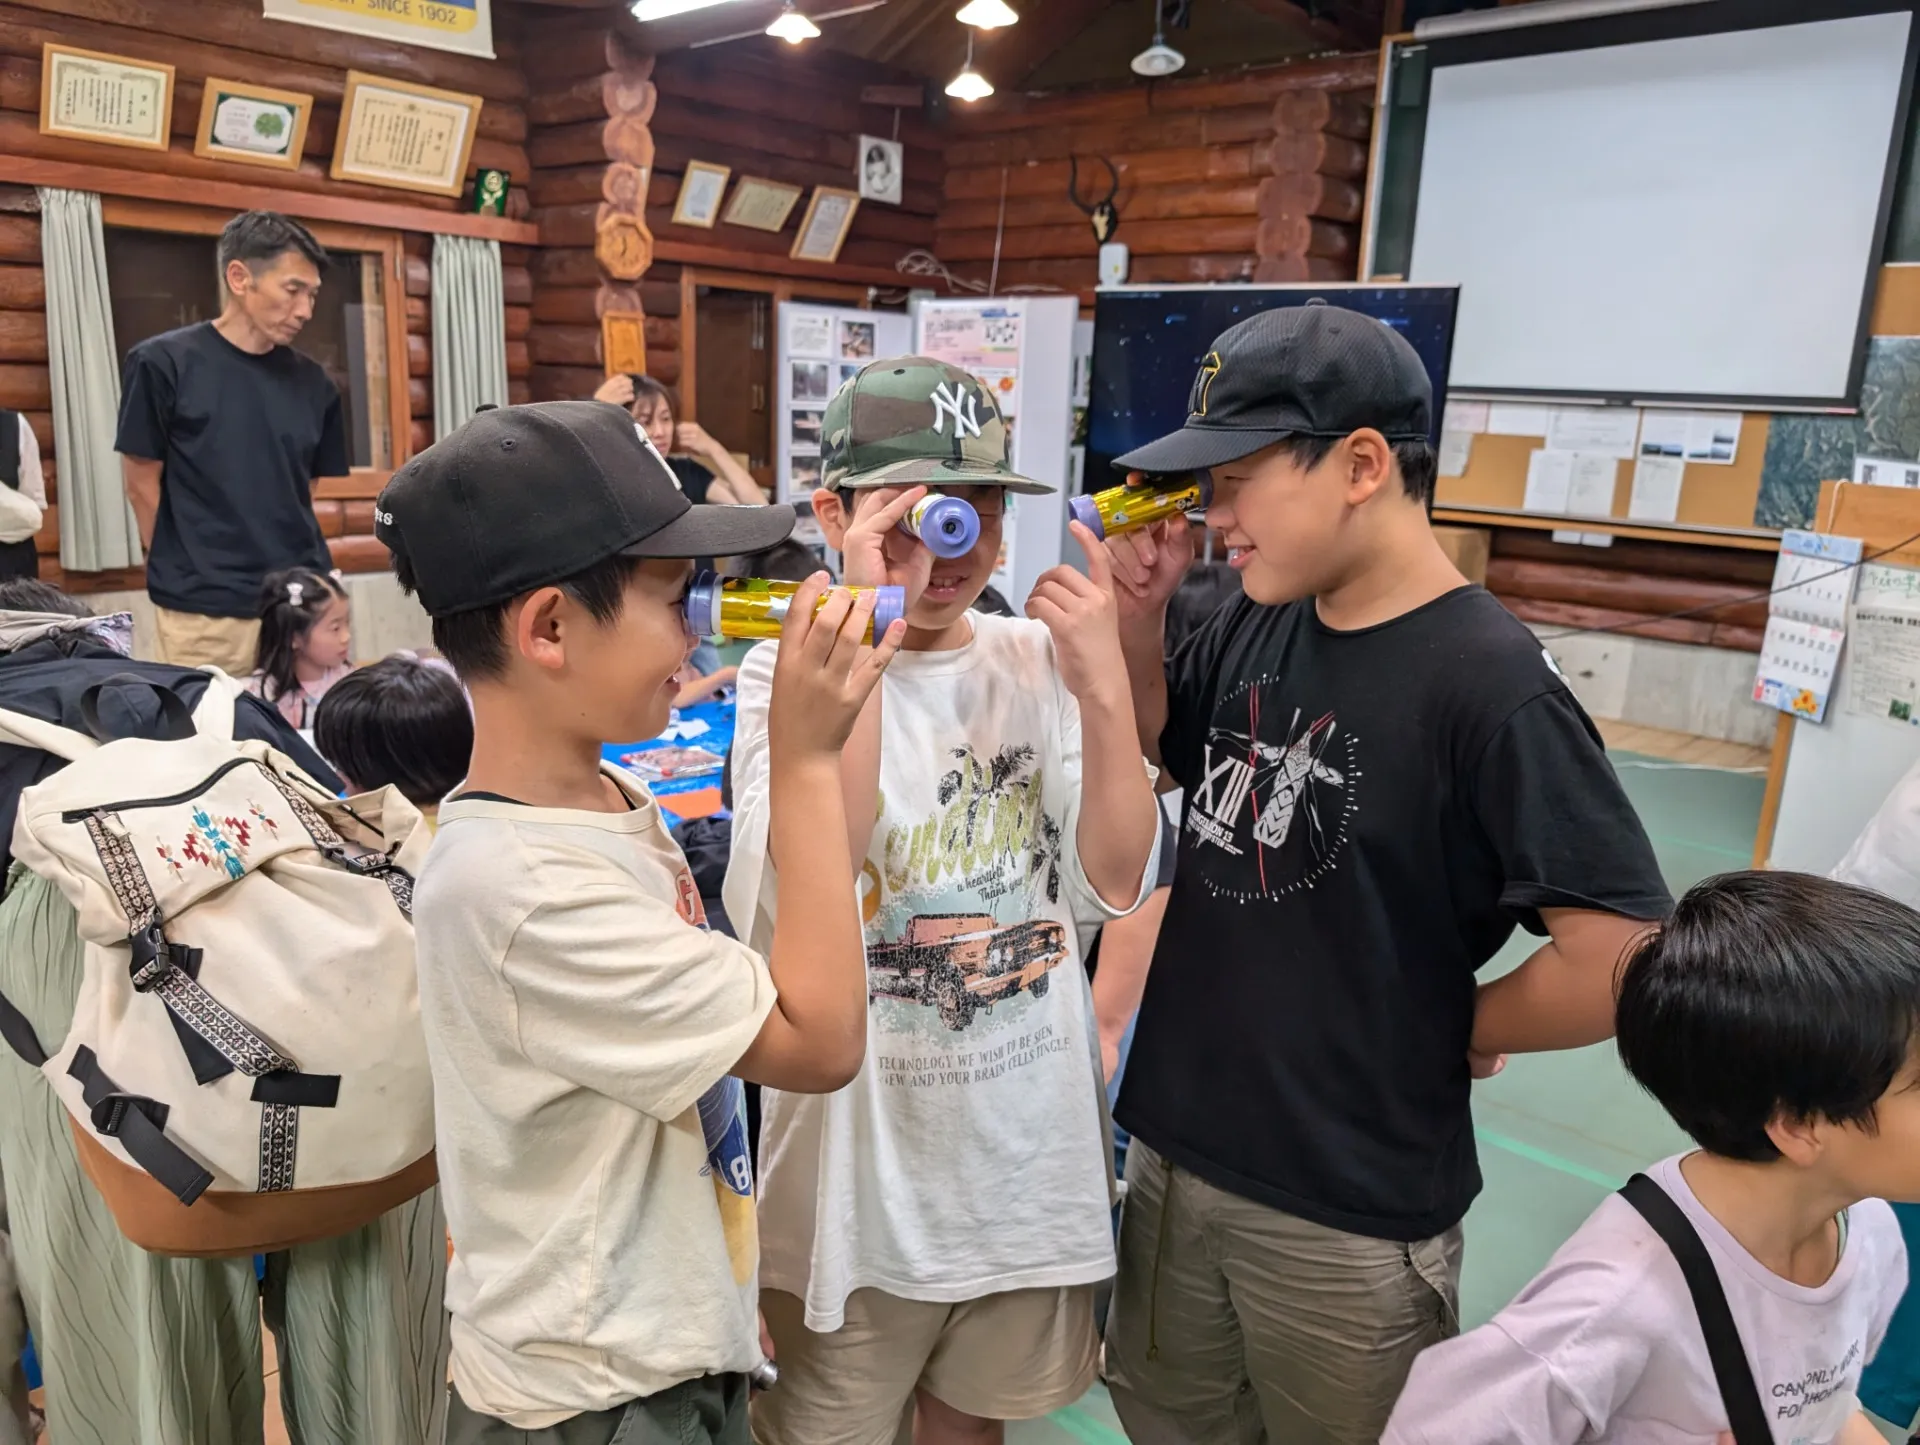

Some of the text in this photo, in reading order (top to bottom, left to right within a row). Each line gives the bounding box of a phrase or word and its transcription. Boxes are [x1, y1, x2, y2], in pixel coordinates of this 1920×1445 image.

[367, 0, 458, 25] SINCE 1902
[929, 380, 982, 439] NY
[1192, 743, 1256, 828] XIII
[1223, 830, 1235, 842] 13
[964, 866, 1005, 889] heartfelt
[978, 882, 1007, 902] Thank
[878, 1054, 953, 1072] TECHNOLOGY
[957, 1053, 975, 1068] WE
[979, 1045, 1004, 1064] WISH
[1019, 1034, 1032, 1049] BE
[910, 1070, 936, 1088] AND
[938, 1070, 970, 1086] YOUR
[974, 1061, 1006, 1083] BRAIN
[1008, 1048, 1036, 1070] CELLS
[1035, 1037, 1071, 1060] TINGLE
[1772, 1380, 1806, 1398] CAN
